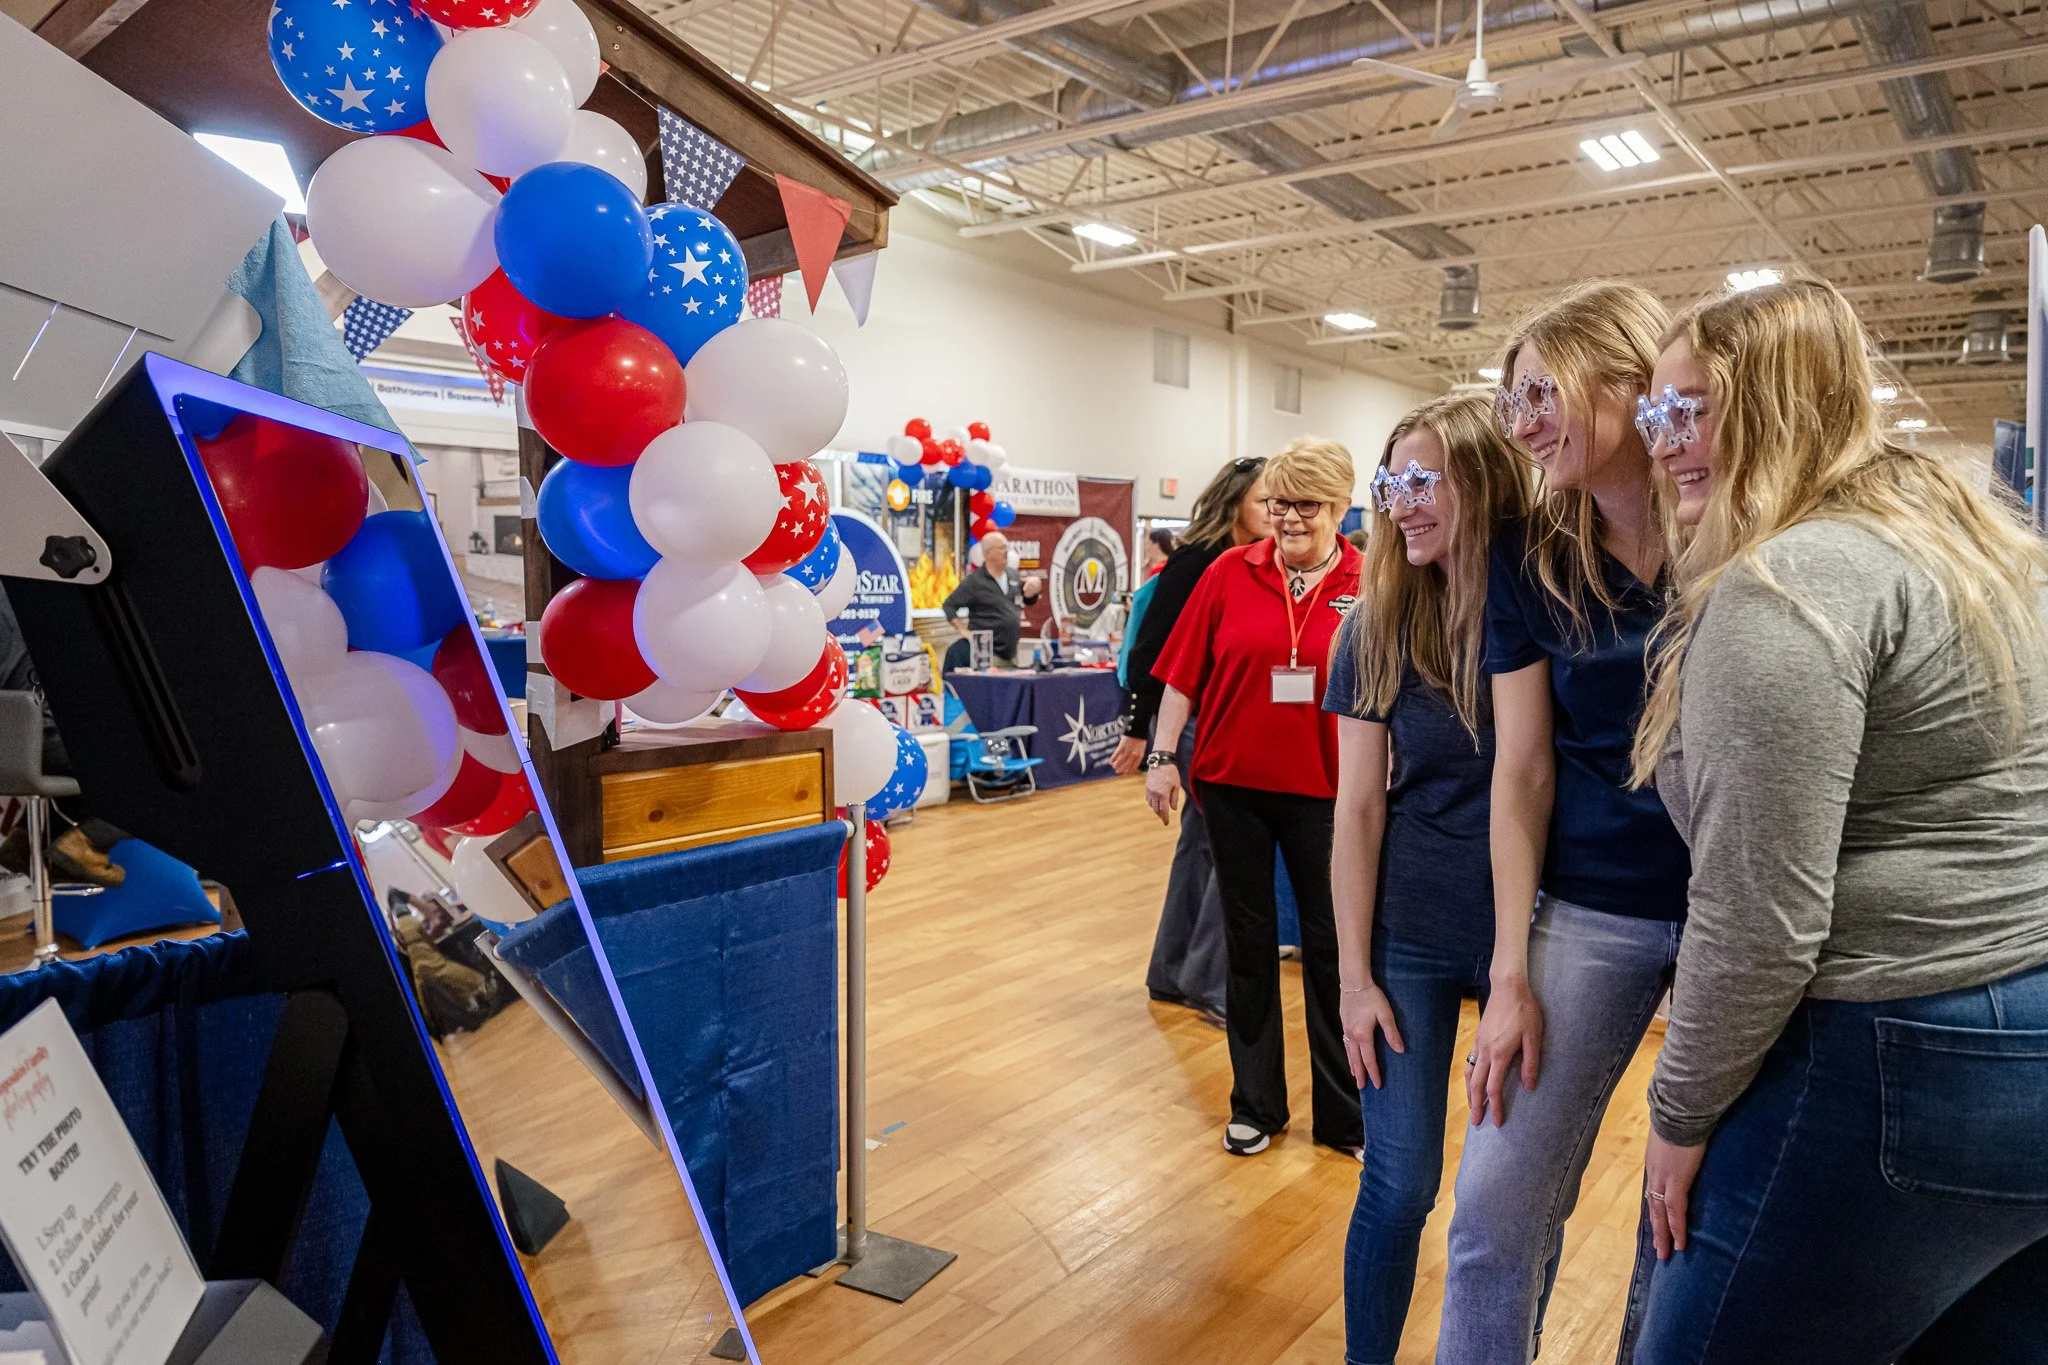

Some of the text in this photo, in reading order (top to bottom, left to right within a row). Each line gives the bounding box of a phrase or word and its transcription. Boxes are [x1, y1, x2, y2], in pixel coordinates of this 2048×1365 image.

[377, 383, 438, 398] Bathrooms
[994, 477, 1075, 497] ARATHON
[18, 1106, 82, 1176] TRY THE PHOTO
